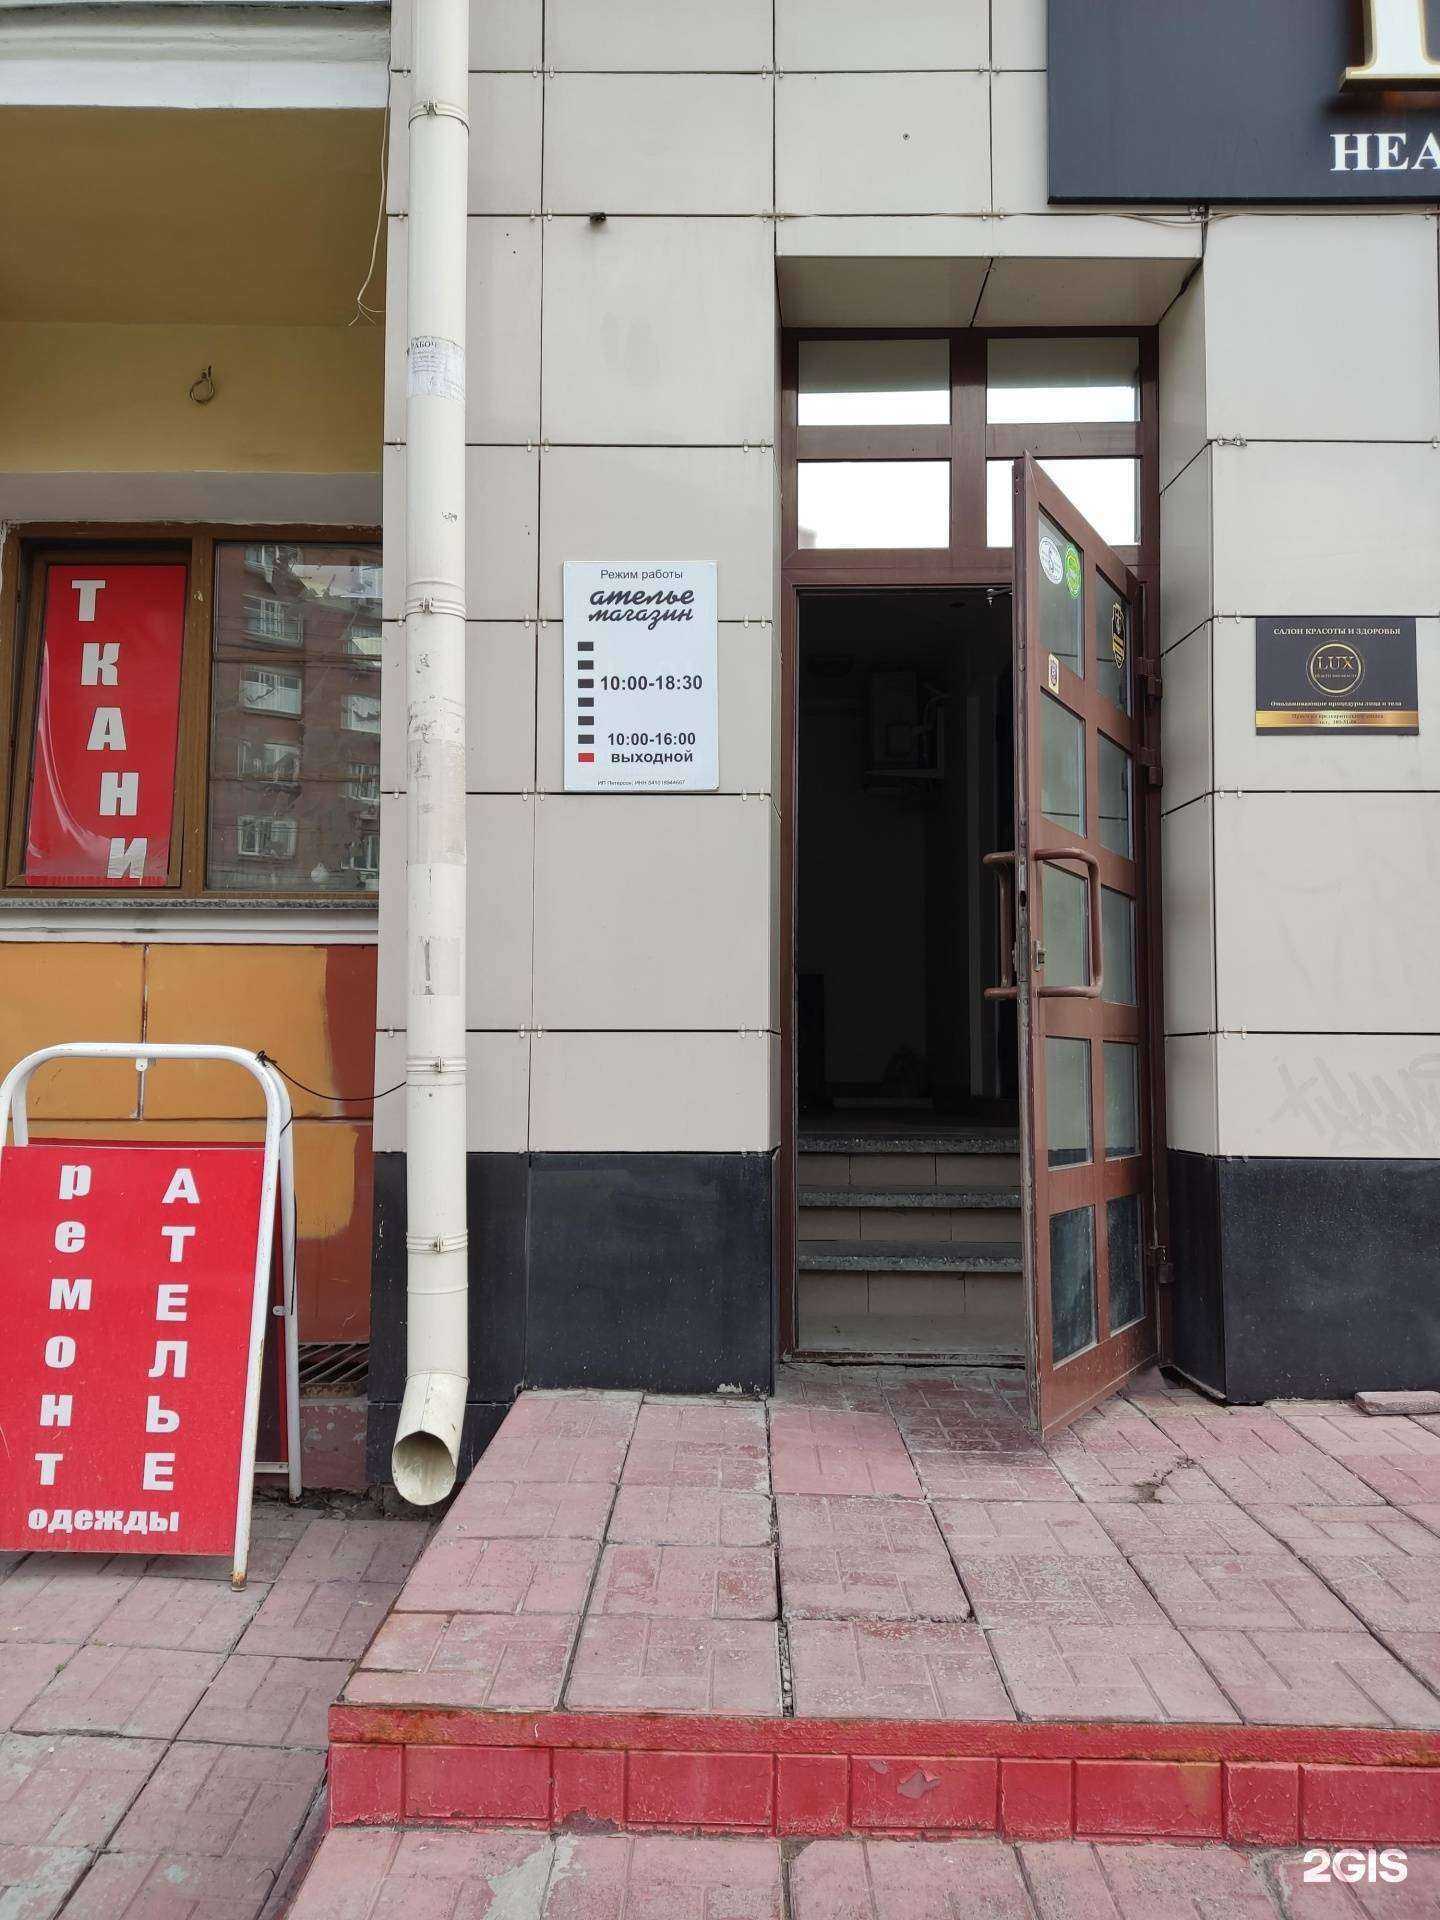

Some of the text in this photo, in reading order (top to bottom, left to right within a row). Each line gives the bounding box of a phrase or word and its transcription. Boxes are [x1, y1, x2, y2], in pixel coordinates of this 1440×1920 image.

[1330, 132, 1440, 171] HEA
[600, 569, 683, 582] Режим работы
[589, 588, 695, 606] ателье
[588, 608, 694, 631] магазин
[1316, 656, 1355, 671] LUX
[600, 674, 703, 691] 10:00-18:30
[71, 580, 148, 879] ТКАНИ
[607, 732, 696, 747] 10:00-16:00
[611, 749, 693, 765] выходной
[34, 1162, 92, 1486] ремонт
[142, 1167, 200, 1491] АТЕЛЬЕ
[28, 1508, 180, 1535] одежды
